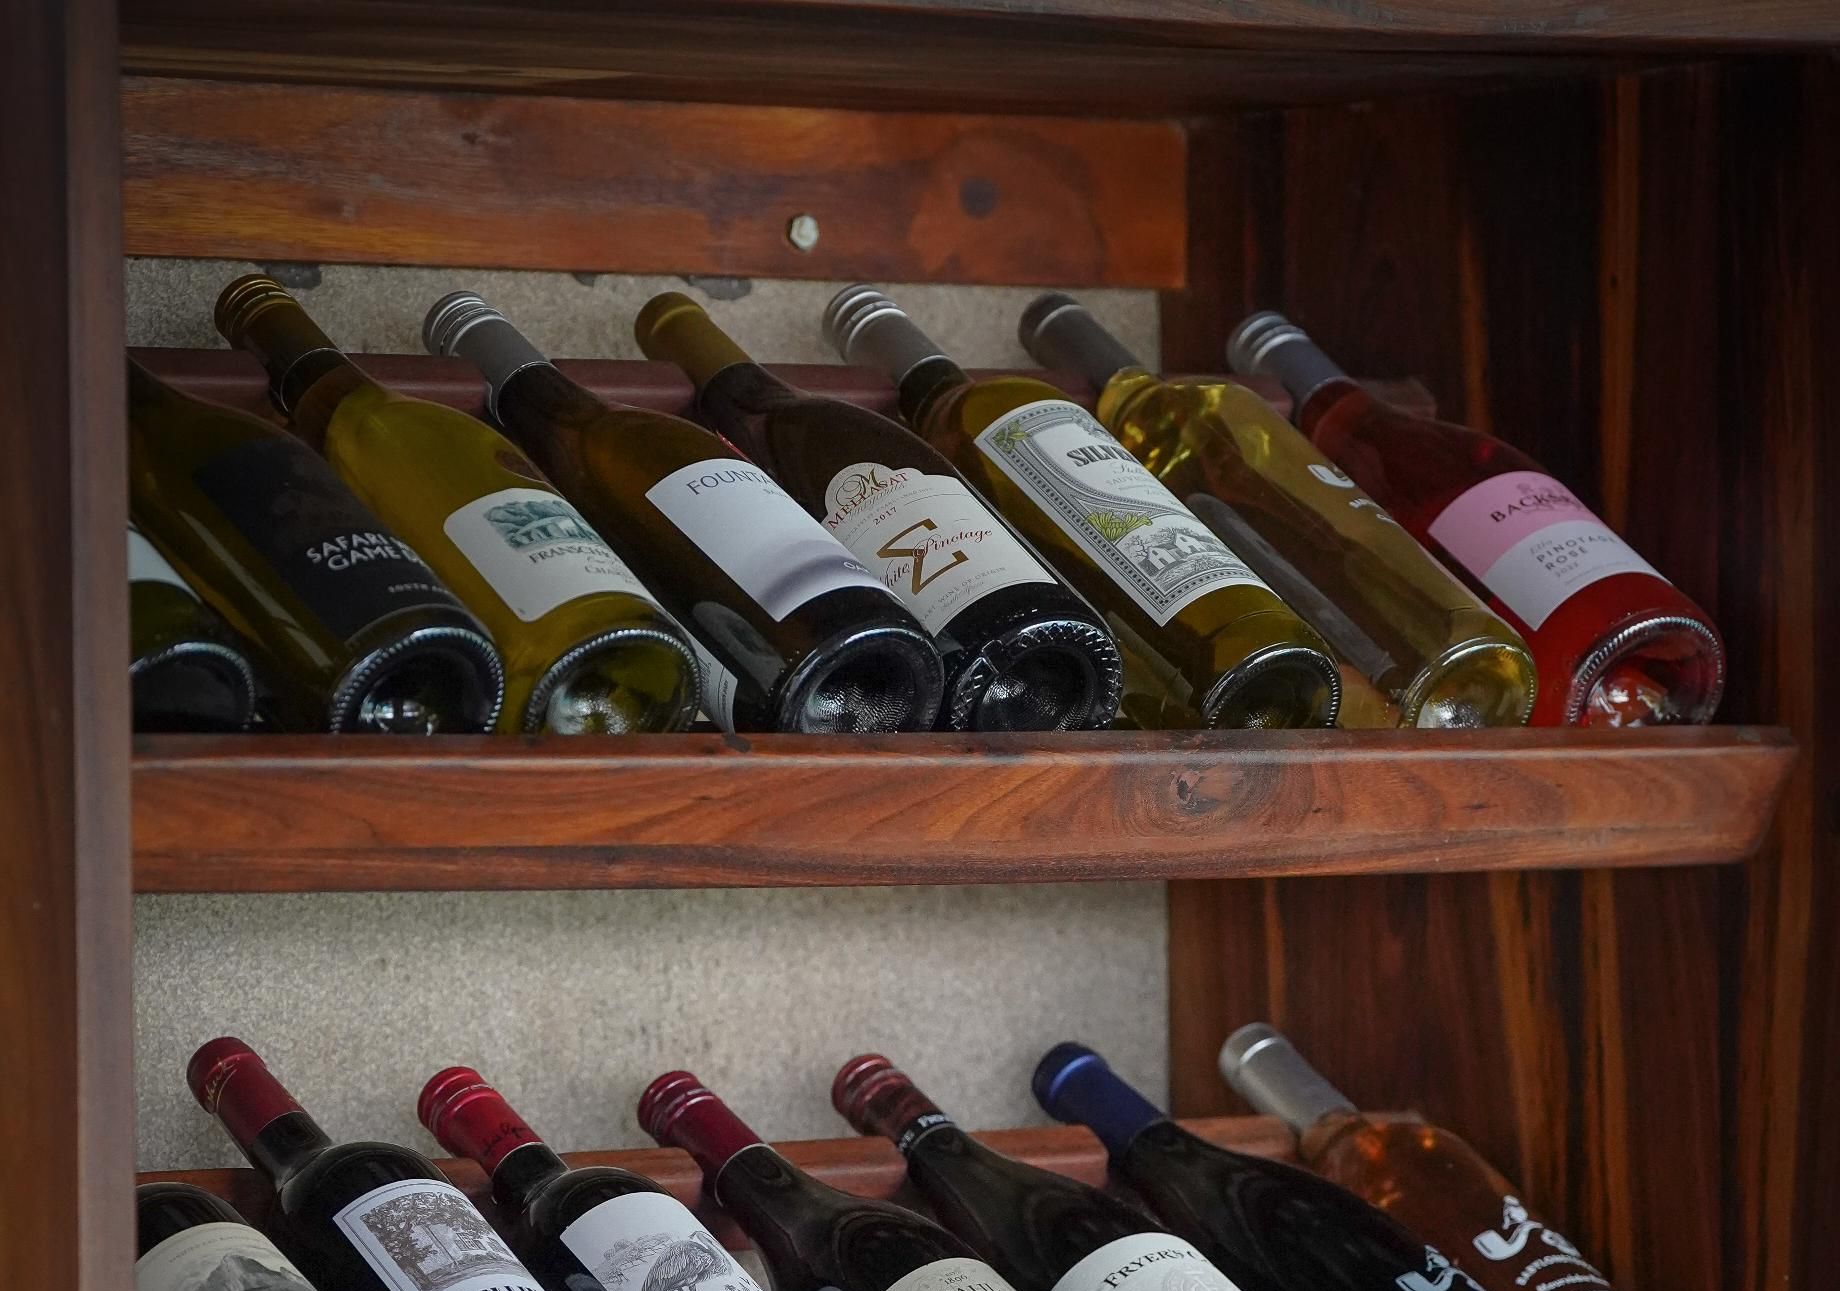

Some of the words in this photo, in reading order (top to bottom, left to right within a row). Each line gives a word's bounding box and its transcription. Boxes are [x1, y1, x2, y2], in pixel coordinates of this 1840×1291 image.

[827, 472, 908, 530] MELLASAT
[874, 506, 897, 525] 2017
[306, 532, 388, 564] SAFARI
[327, 545, 401, 571] GAME
[912, 529, 993, 561] Pinotage
